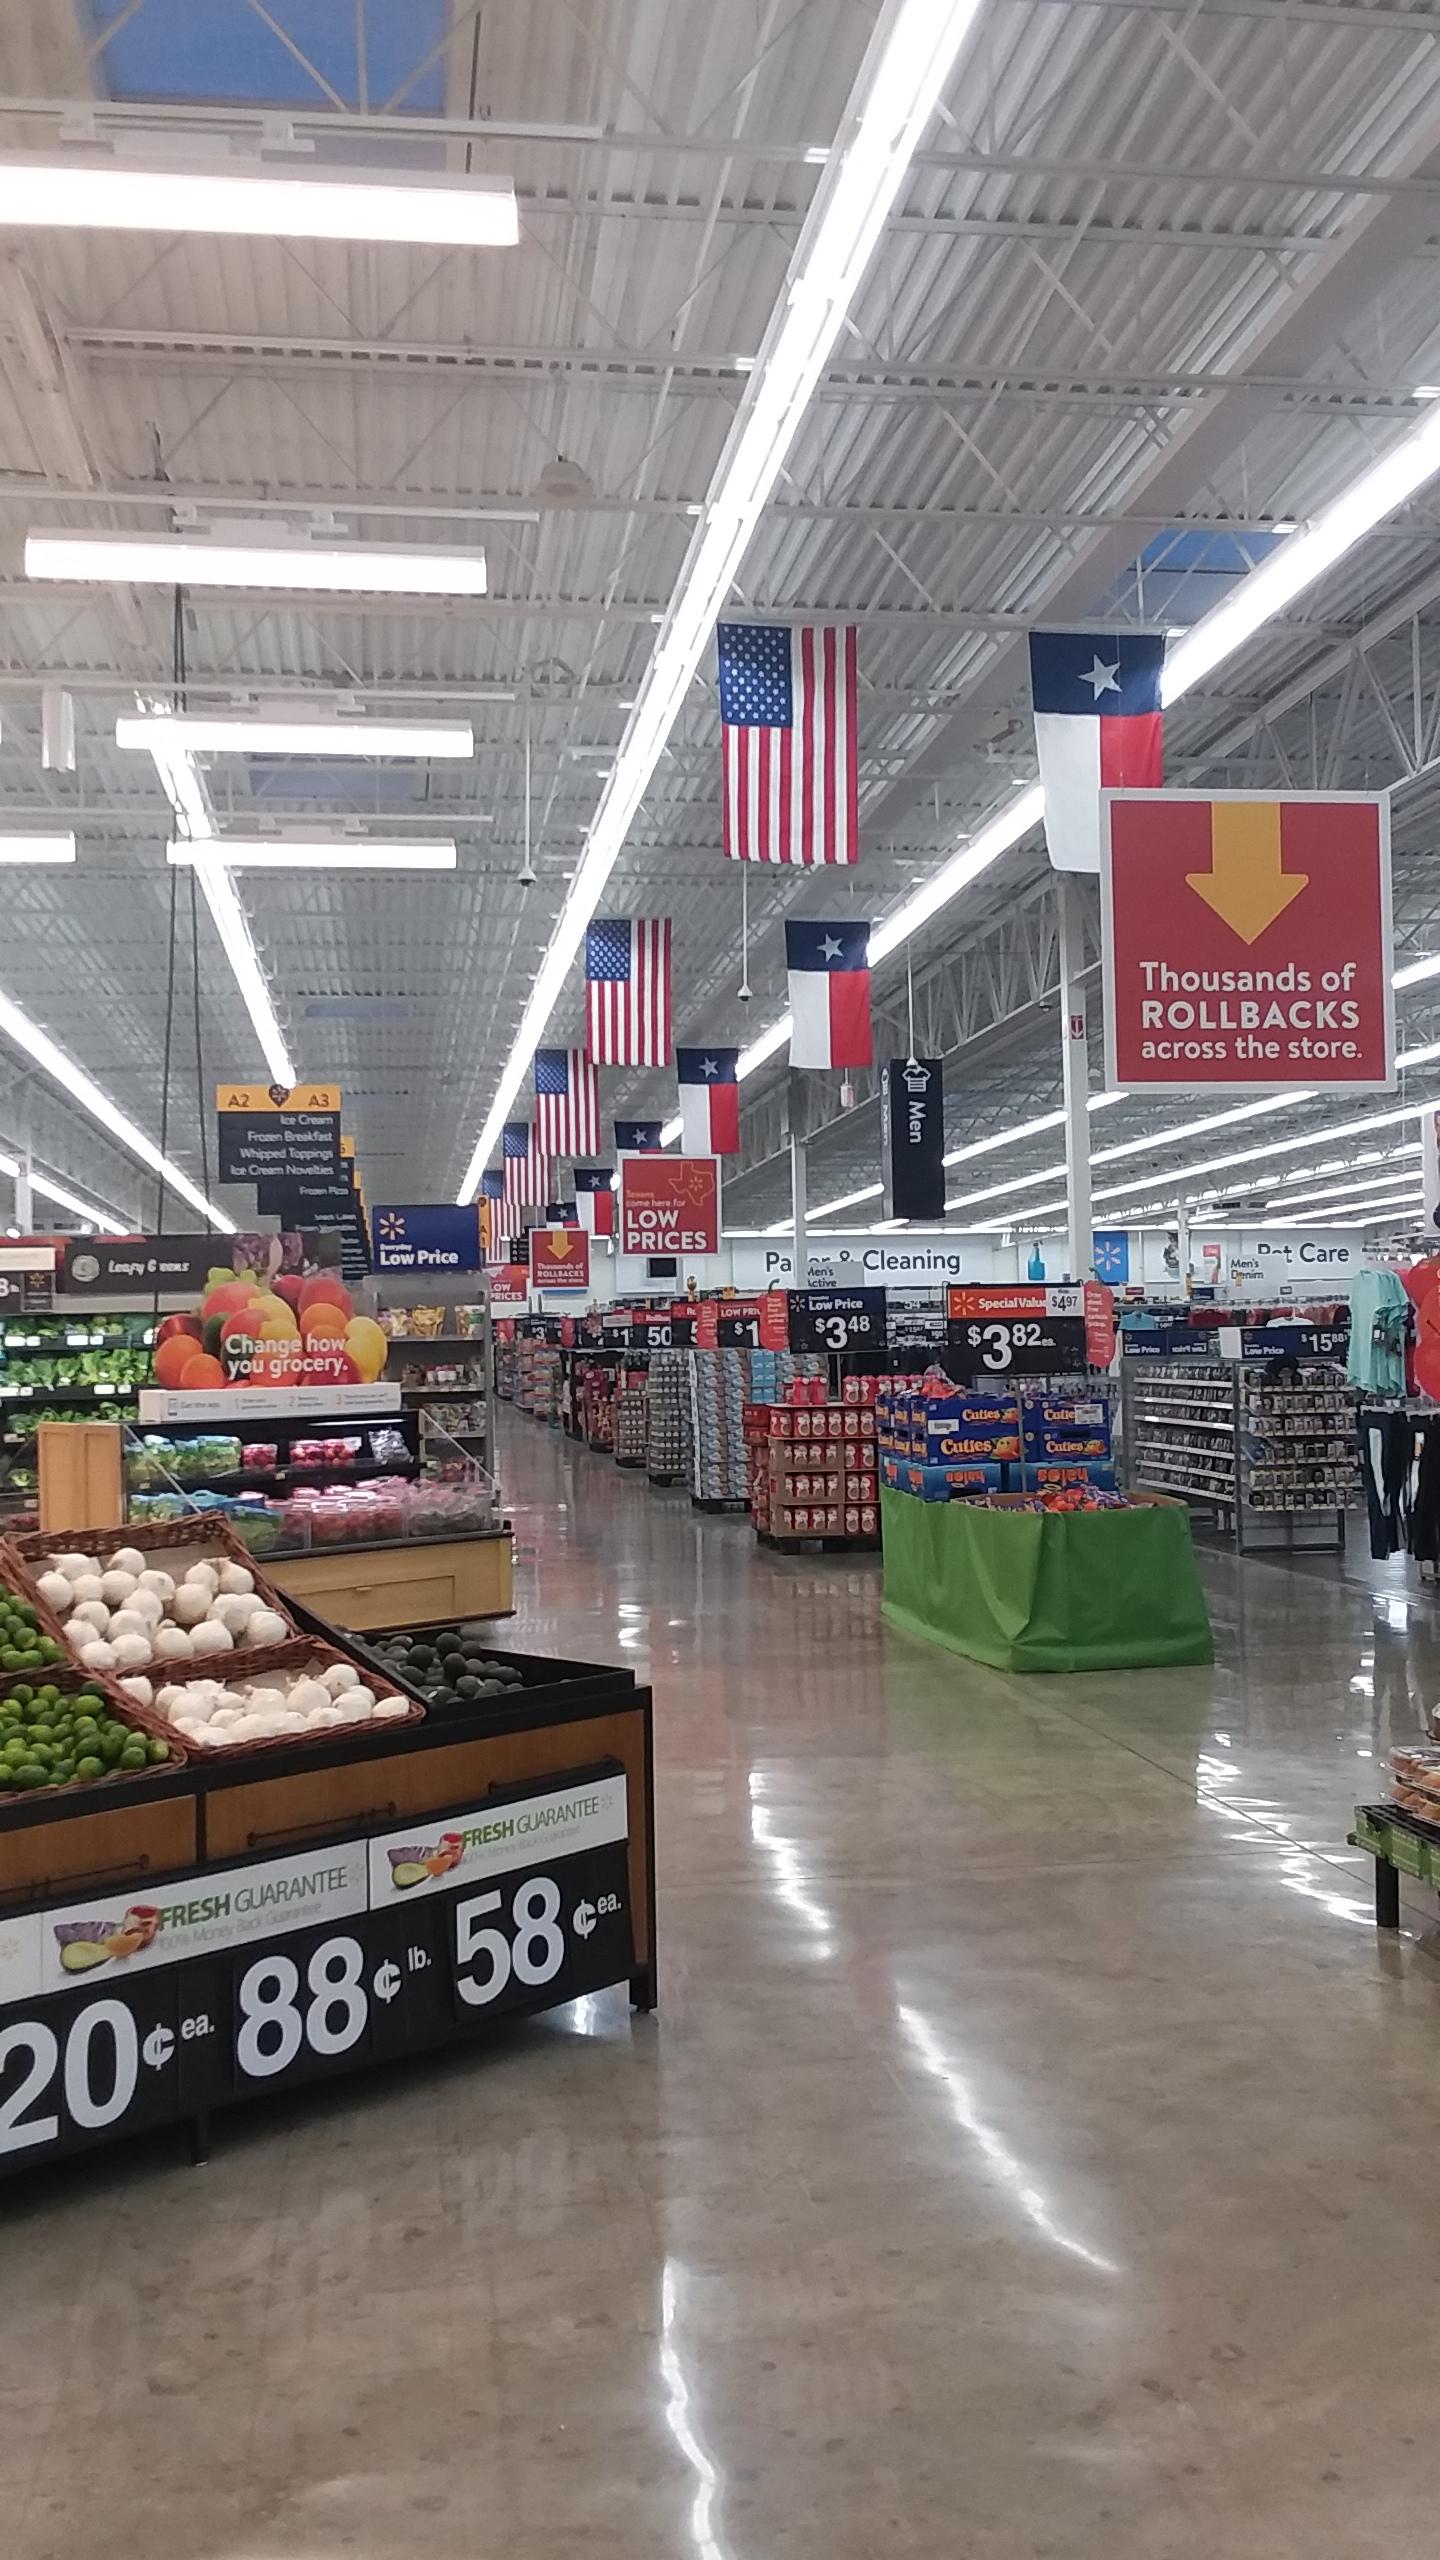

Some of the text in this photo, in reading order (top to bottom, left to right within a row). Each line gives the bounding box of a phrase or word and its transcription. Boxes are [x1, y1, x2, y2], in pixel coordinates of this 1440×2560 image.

[1139, 961, 1357, 992] Thousands of
[1142, 1000, 1360, 1030] ROLLBACKS
[1141, 1034, 1363, 1059] across the store.
[228, 1094, 250, 1108] A2
[308, 1094, 330, 1107] A3
[280, 1114, 334, 1125] Ice Cream
[908, 1101, 926, 1144] Men
[247, 1131, 334, 1142] Frozen Breakfast
[240, 1148, 334, 1161] Whipped Toppings
[230, 1164, 334, 1176] Ice Cream Novelties
[300, 1186, 327, 1195] Frozen
[651, 1198, 671, 1207] here
[673, 1198, 686, 1207] for
[627, 1209, 679, 1229] LOW
[627, 1231, 707, 1250] PRICES
[380, 1251, 415, 1266] Low
[417, 1249, 459, 1265] Price
[1300, 1243, 1350, 1263] Care
[108, 1259, 144, 1276] Leafy
[863, 1249, 960, 1275] Cleaning
[1230, 1259, 1259, 1269] Men's
[808, 1299, 863, 1311] Low Price
[978, 1297, 1018, 1312] Special
[721, 1308, 741, 1317] LOW
[225, 1333, 346, 1357] Change how
[1263, 1347, 1285, 1356] Price
[227, 1356, 348, 1380] you grocery.
[962, 1409, 1001, 1422] Cuties
[1043, 1409, 1076, 1421] Cutie
[940, 1438, 993, 1456] Cuties
[1046, 1440, 1084, 1454] Cuties
[463, 1796, 599, 1849] FRESH GUARANTEE
[160, 1866, 348, 1931] FRESH GUARANTEE
